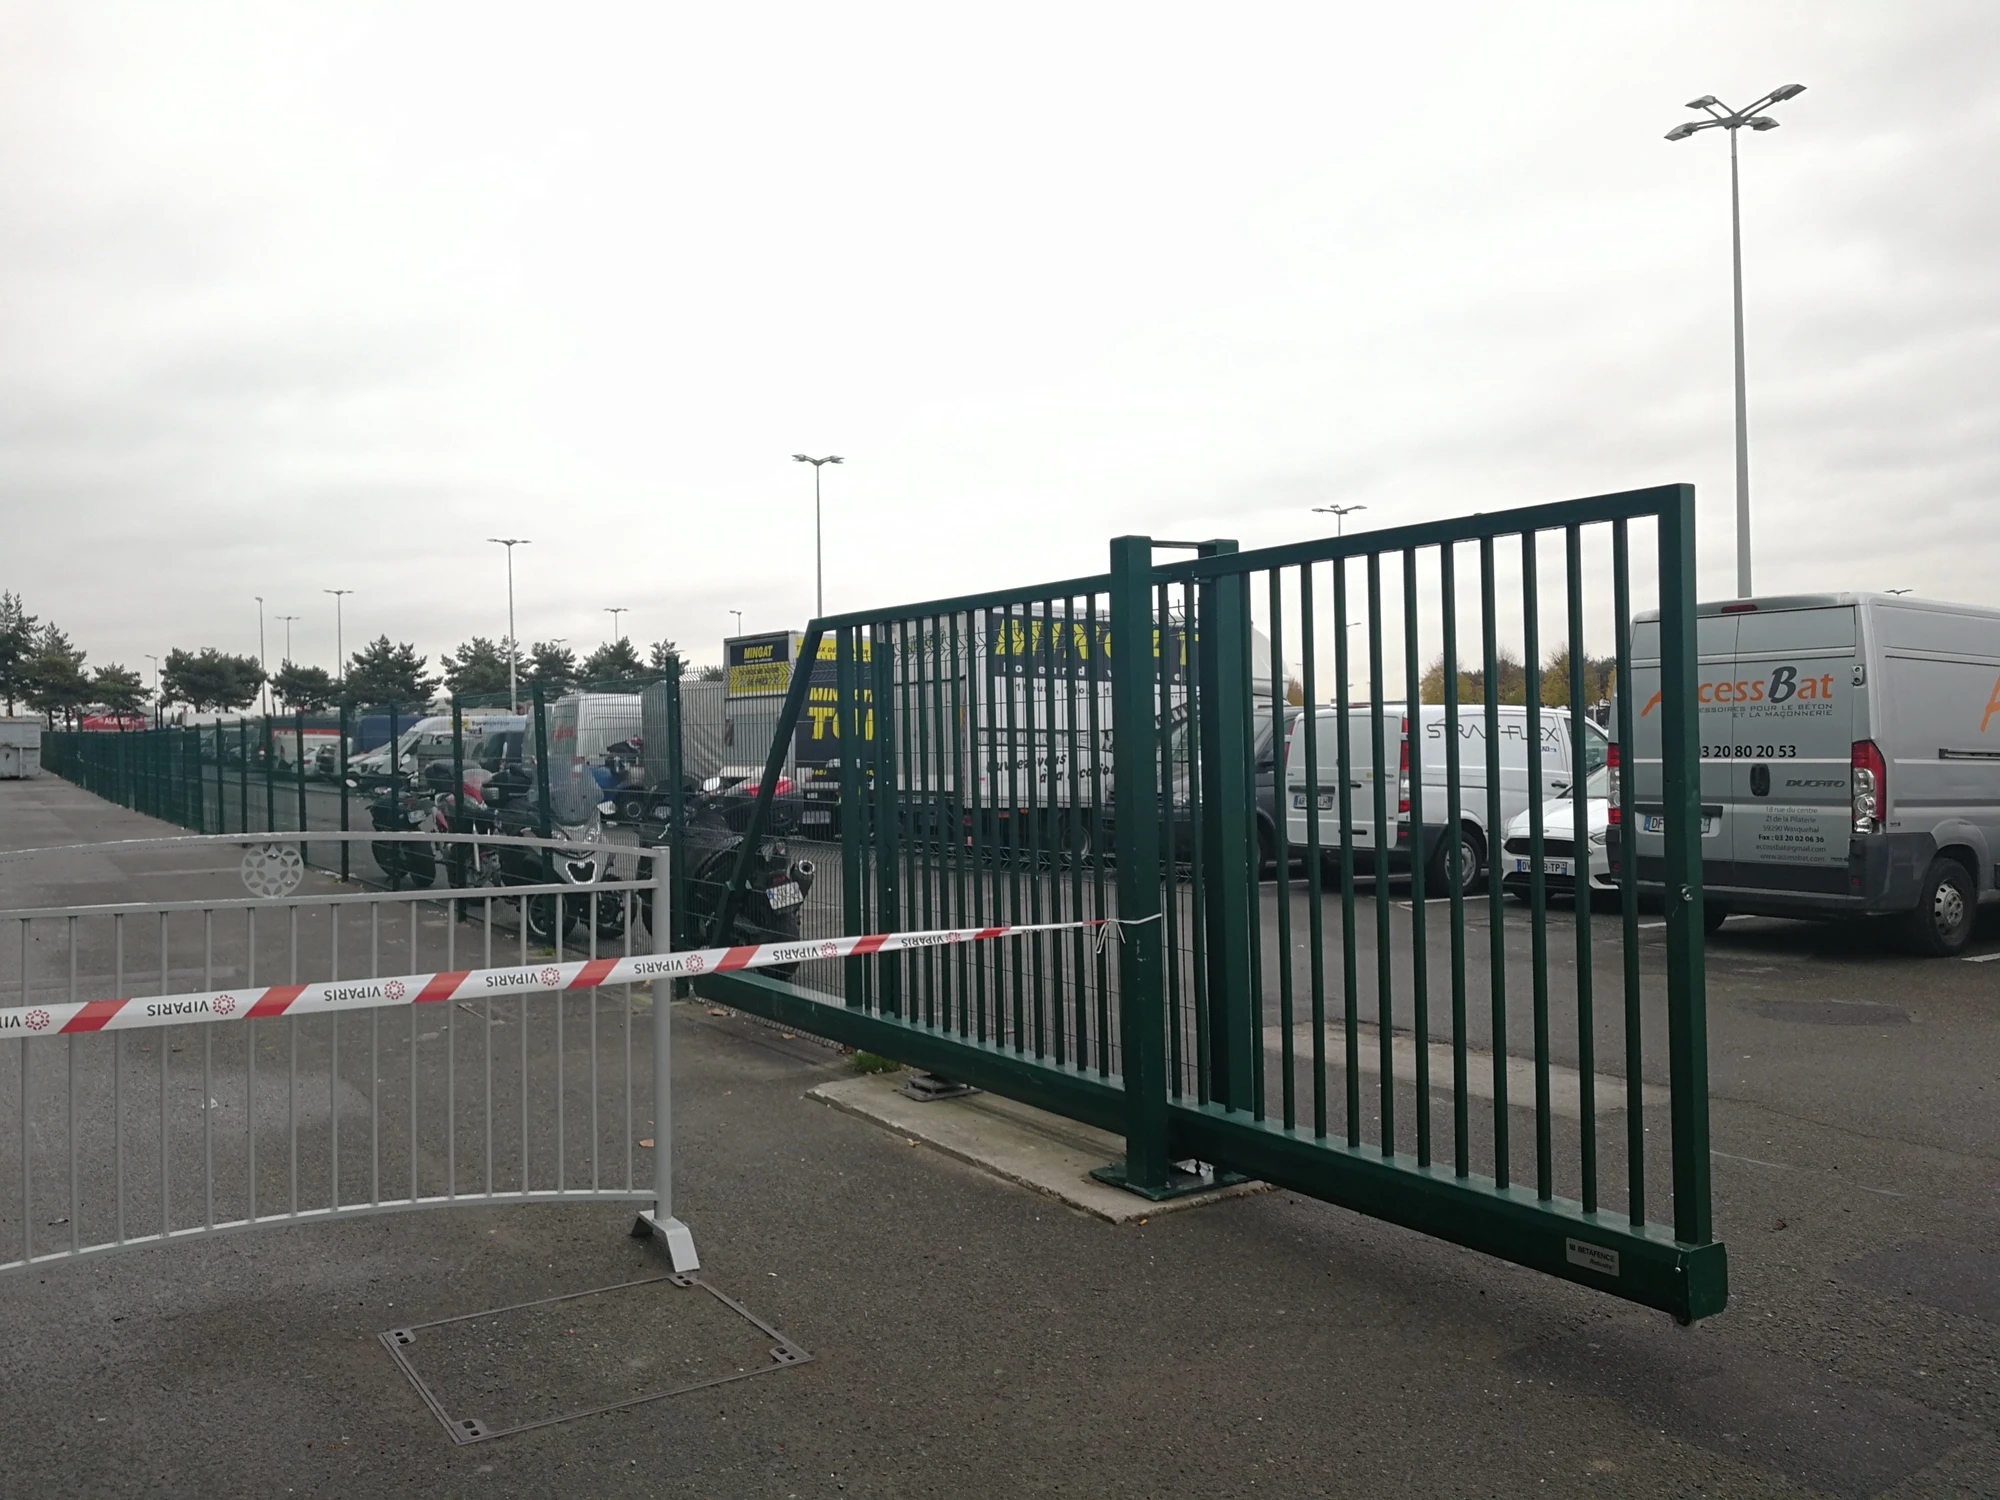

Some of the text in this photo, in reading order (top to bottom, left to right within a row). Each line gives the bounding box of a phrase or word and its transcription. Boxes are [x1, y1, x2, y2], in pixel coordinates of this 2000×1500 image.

[744, 645, 773, 659] MINGAT
[1641, 666, 1834, 717] cessBat
[1750, 704, 1777, 712] POUR
[1797, 702, 1833, 710] BÉTON
[1764, 710, 1833, 719] MAÇONNERIE
[1700, 745, 1797, 758] 3 20 80 20 53
[1785, 779, 1846, 788] DUCATO
[1786, 806, 1796, 814] du
[1782, 815, 1789, 823] la
[1784, 834, 1794, 842] 20
[901, 936, 944, 947] VIPARIS
[773, 946, 820, 961] VIPARIS
[634, 959, 684, 974] VIPARIS
[486, 972, 538, 987] VIPARIS
[324, 985, 381, 1001] VIPARIS
[147, 1000, 209, 1017] VIPARIS
[1577, 1245, 1616, 1262] BETAFENCE
